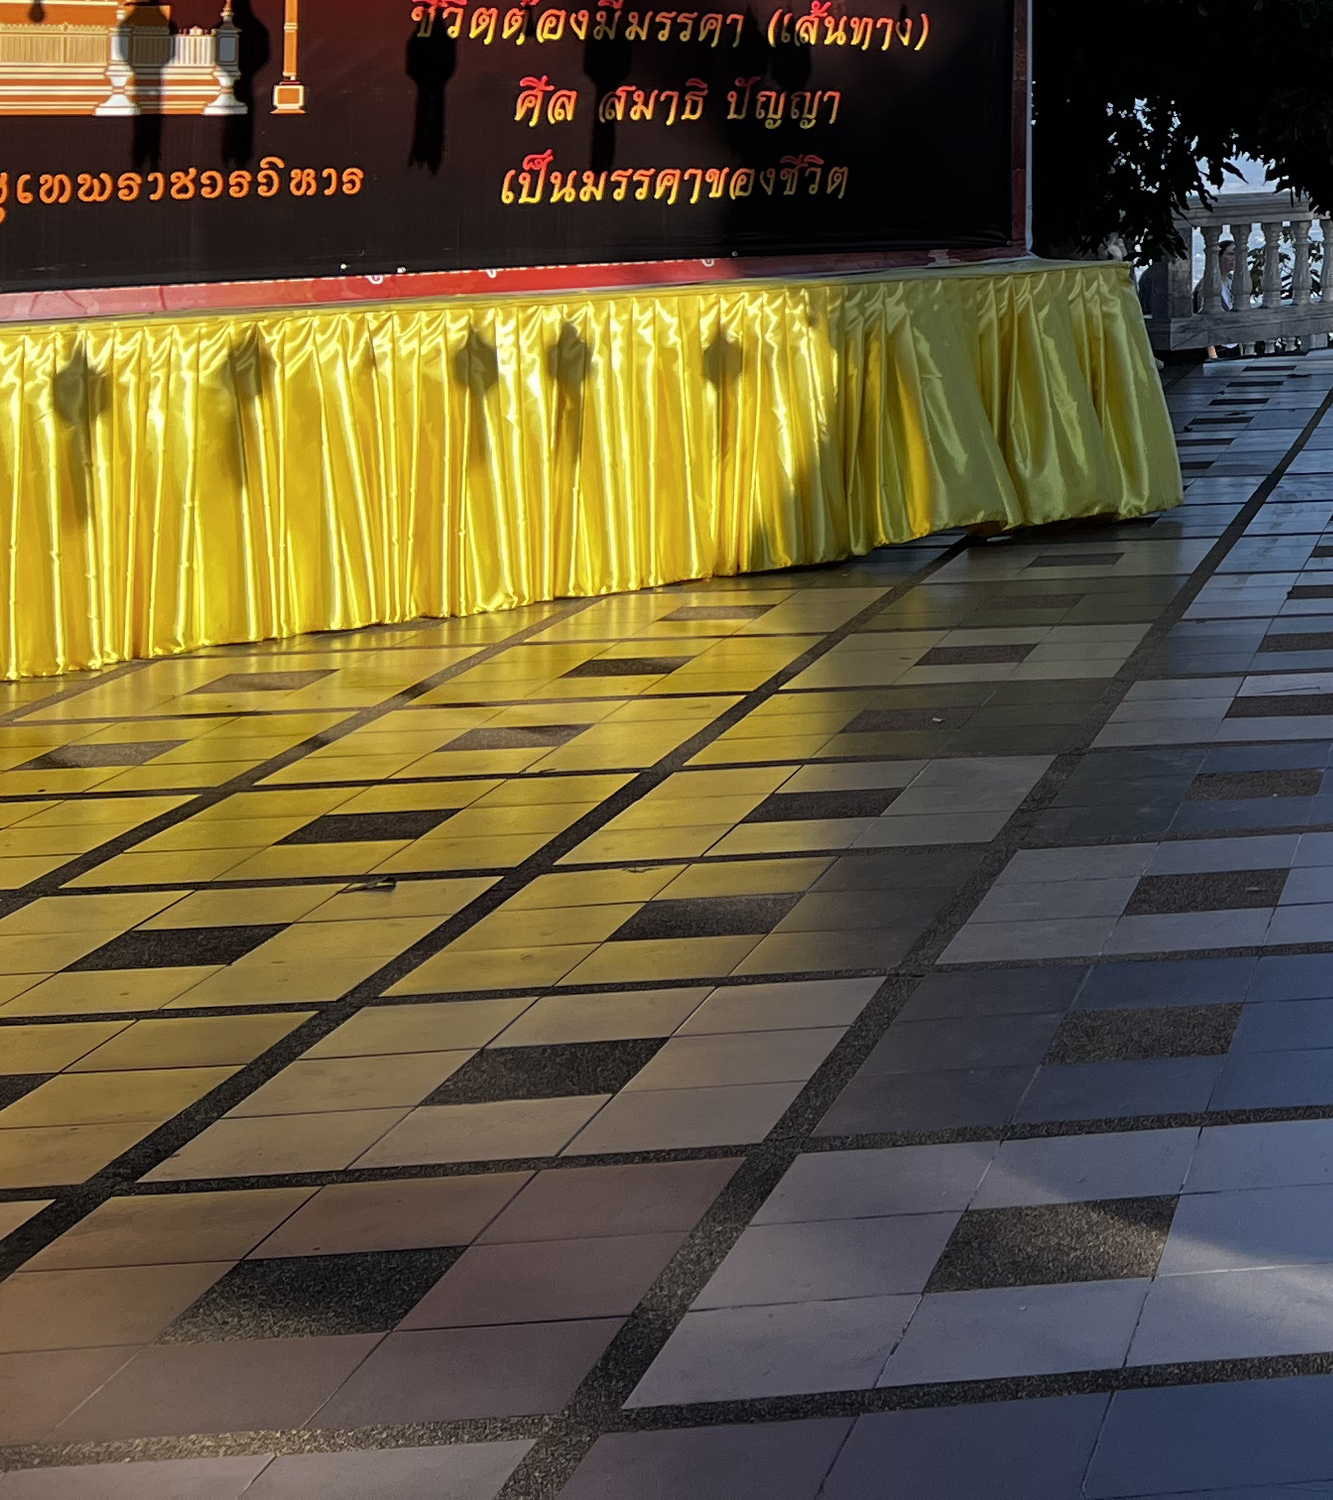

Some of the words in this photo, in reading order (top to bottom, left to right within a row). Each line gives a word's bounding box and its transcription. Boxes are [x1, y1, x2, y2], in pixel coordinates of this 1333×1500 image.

[766, 0, 930, 51] (เส้นทาง)
[513, 75, 577, 127] ศีล
[598, 77, 710, 126] สมาธิ
[726, 76, 842, 129] ปัญญา
[0, 156, 365, 225] เทพราชวรวิหาร
[500, 149, 849, 204] เป็นมรรคาของชีวิต
